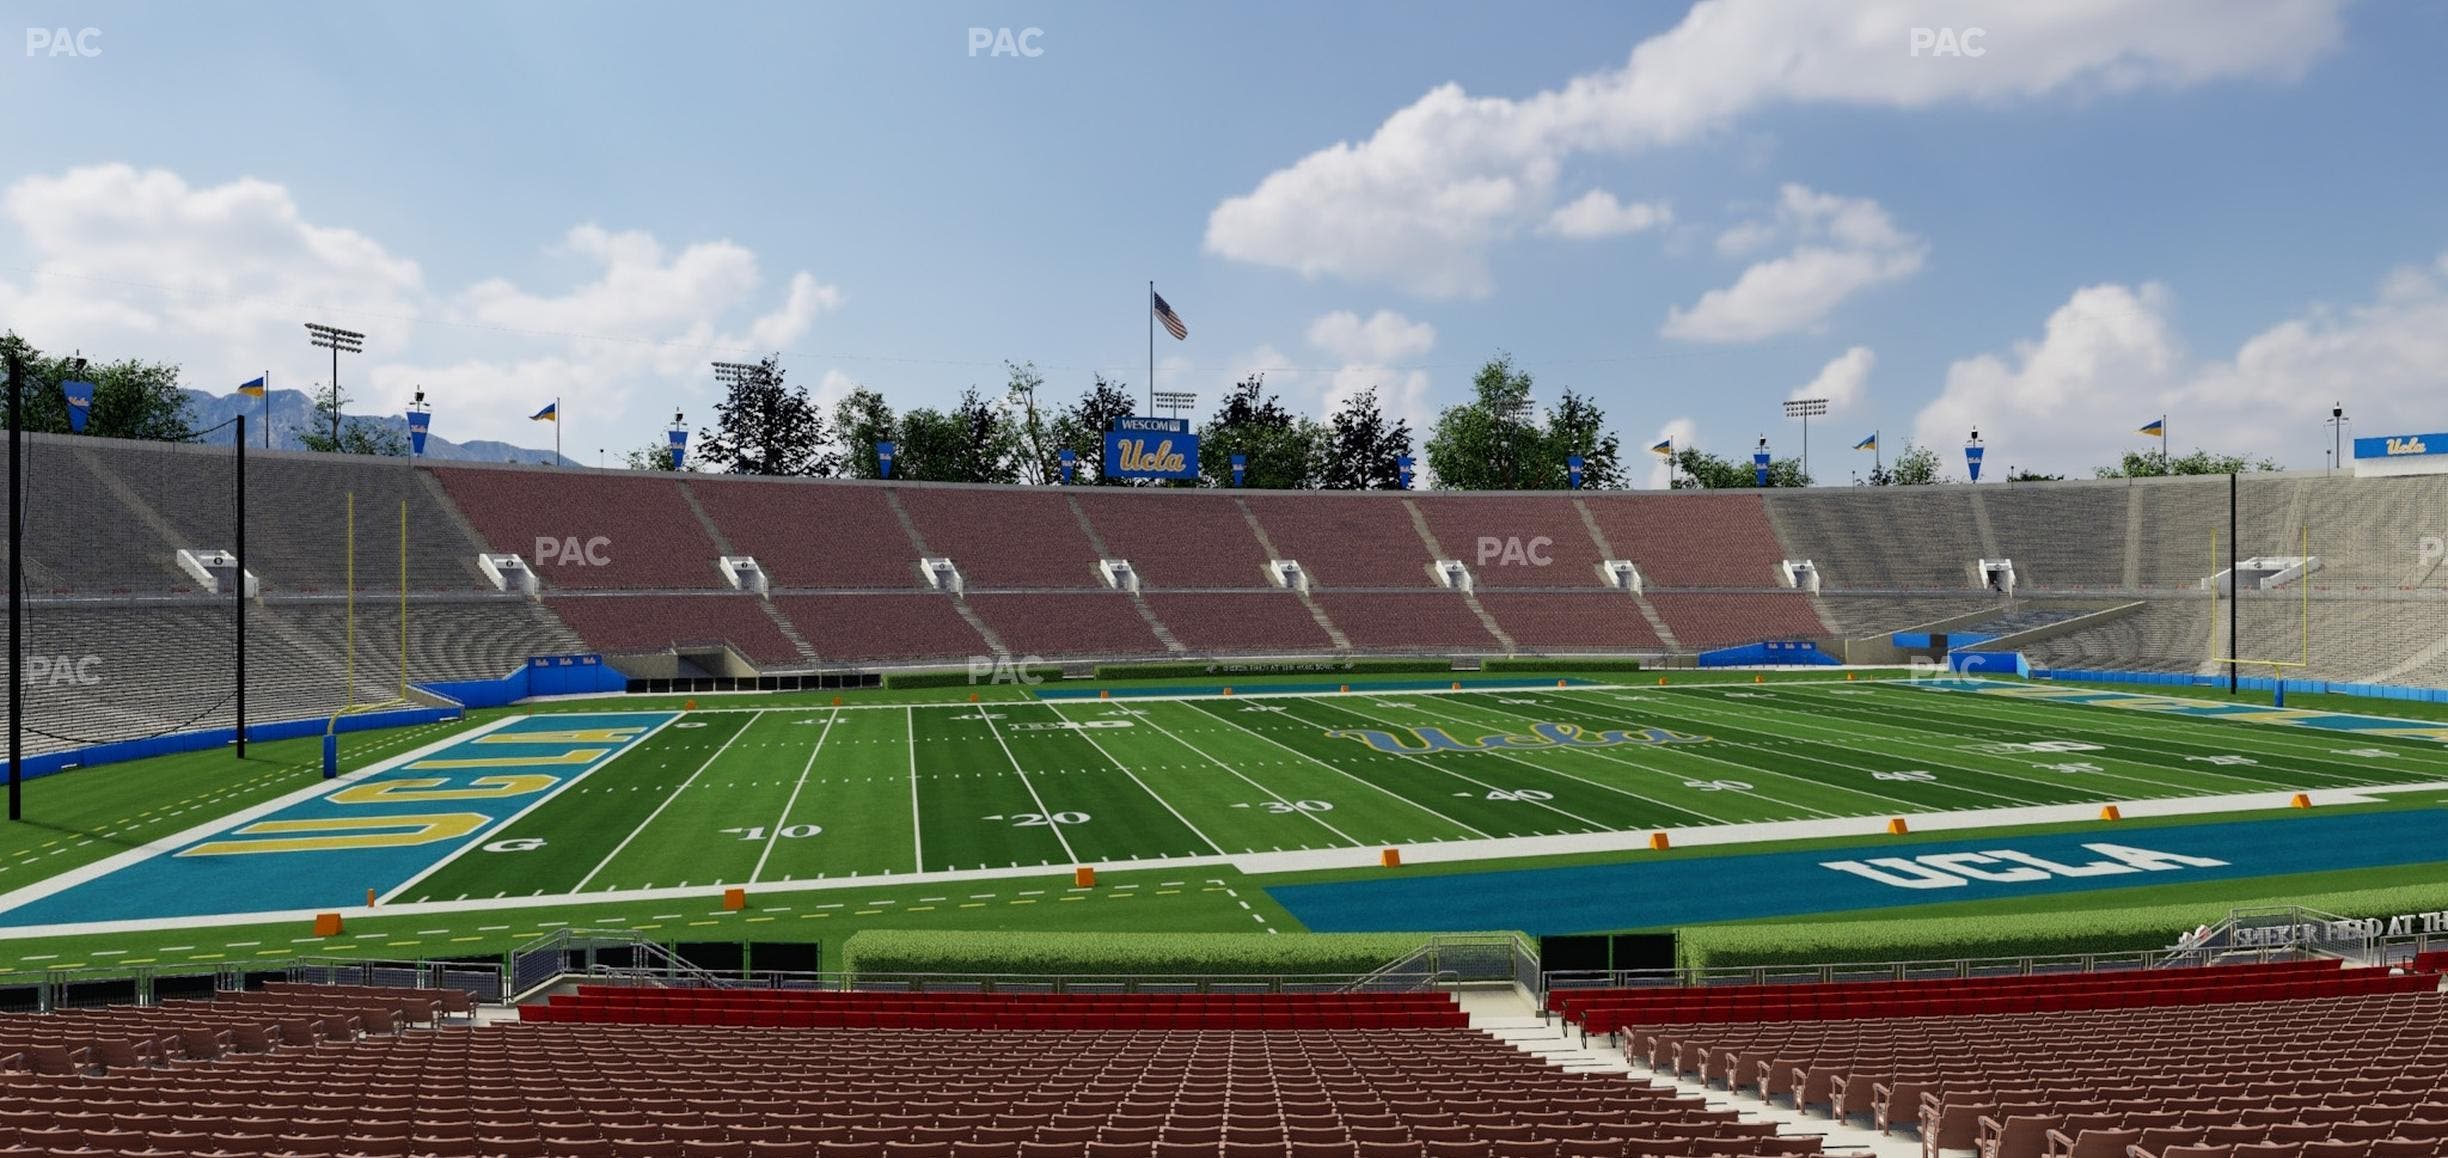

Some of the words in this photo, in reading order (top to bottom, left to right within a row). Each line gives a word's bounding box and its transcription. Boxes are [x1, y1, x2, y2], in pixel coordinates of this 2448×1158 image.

[1122, 419, 1168, 431] WESCOM
[1117, 439, 1187, 472] Ucla
[1323, 722, 1714, 754] Ucla
[172, 727, 649, 858] UCLA
[1683, 779, 1755, 792] 50
[1485, 789, 1555, 802] 40
[1259, 799, 1335, 814] 30
[1010, 811, 1092, 827] 20
[737, 824, 824, 841] 10
[482, 837, 548, 854] G
[1817, 842, 2232, 890] UCLA
[2387, 914, 2417, 935] AT
